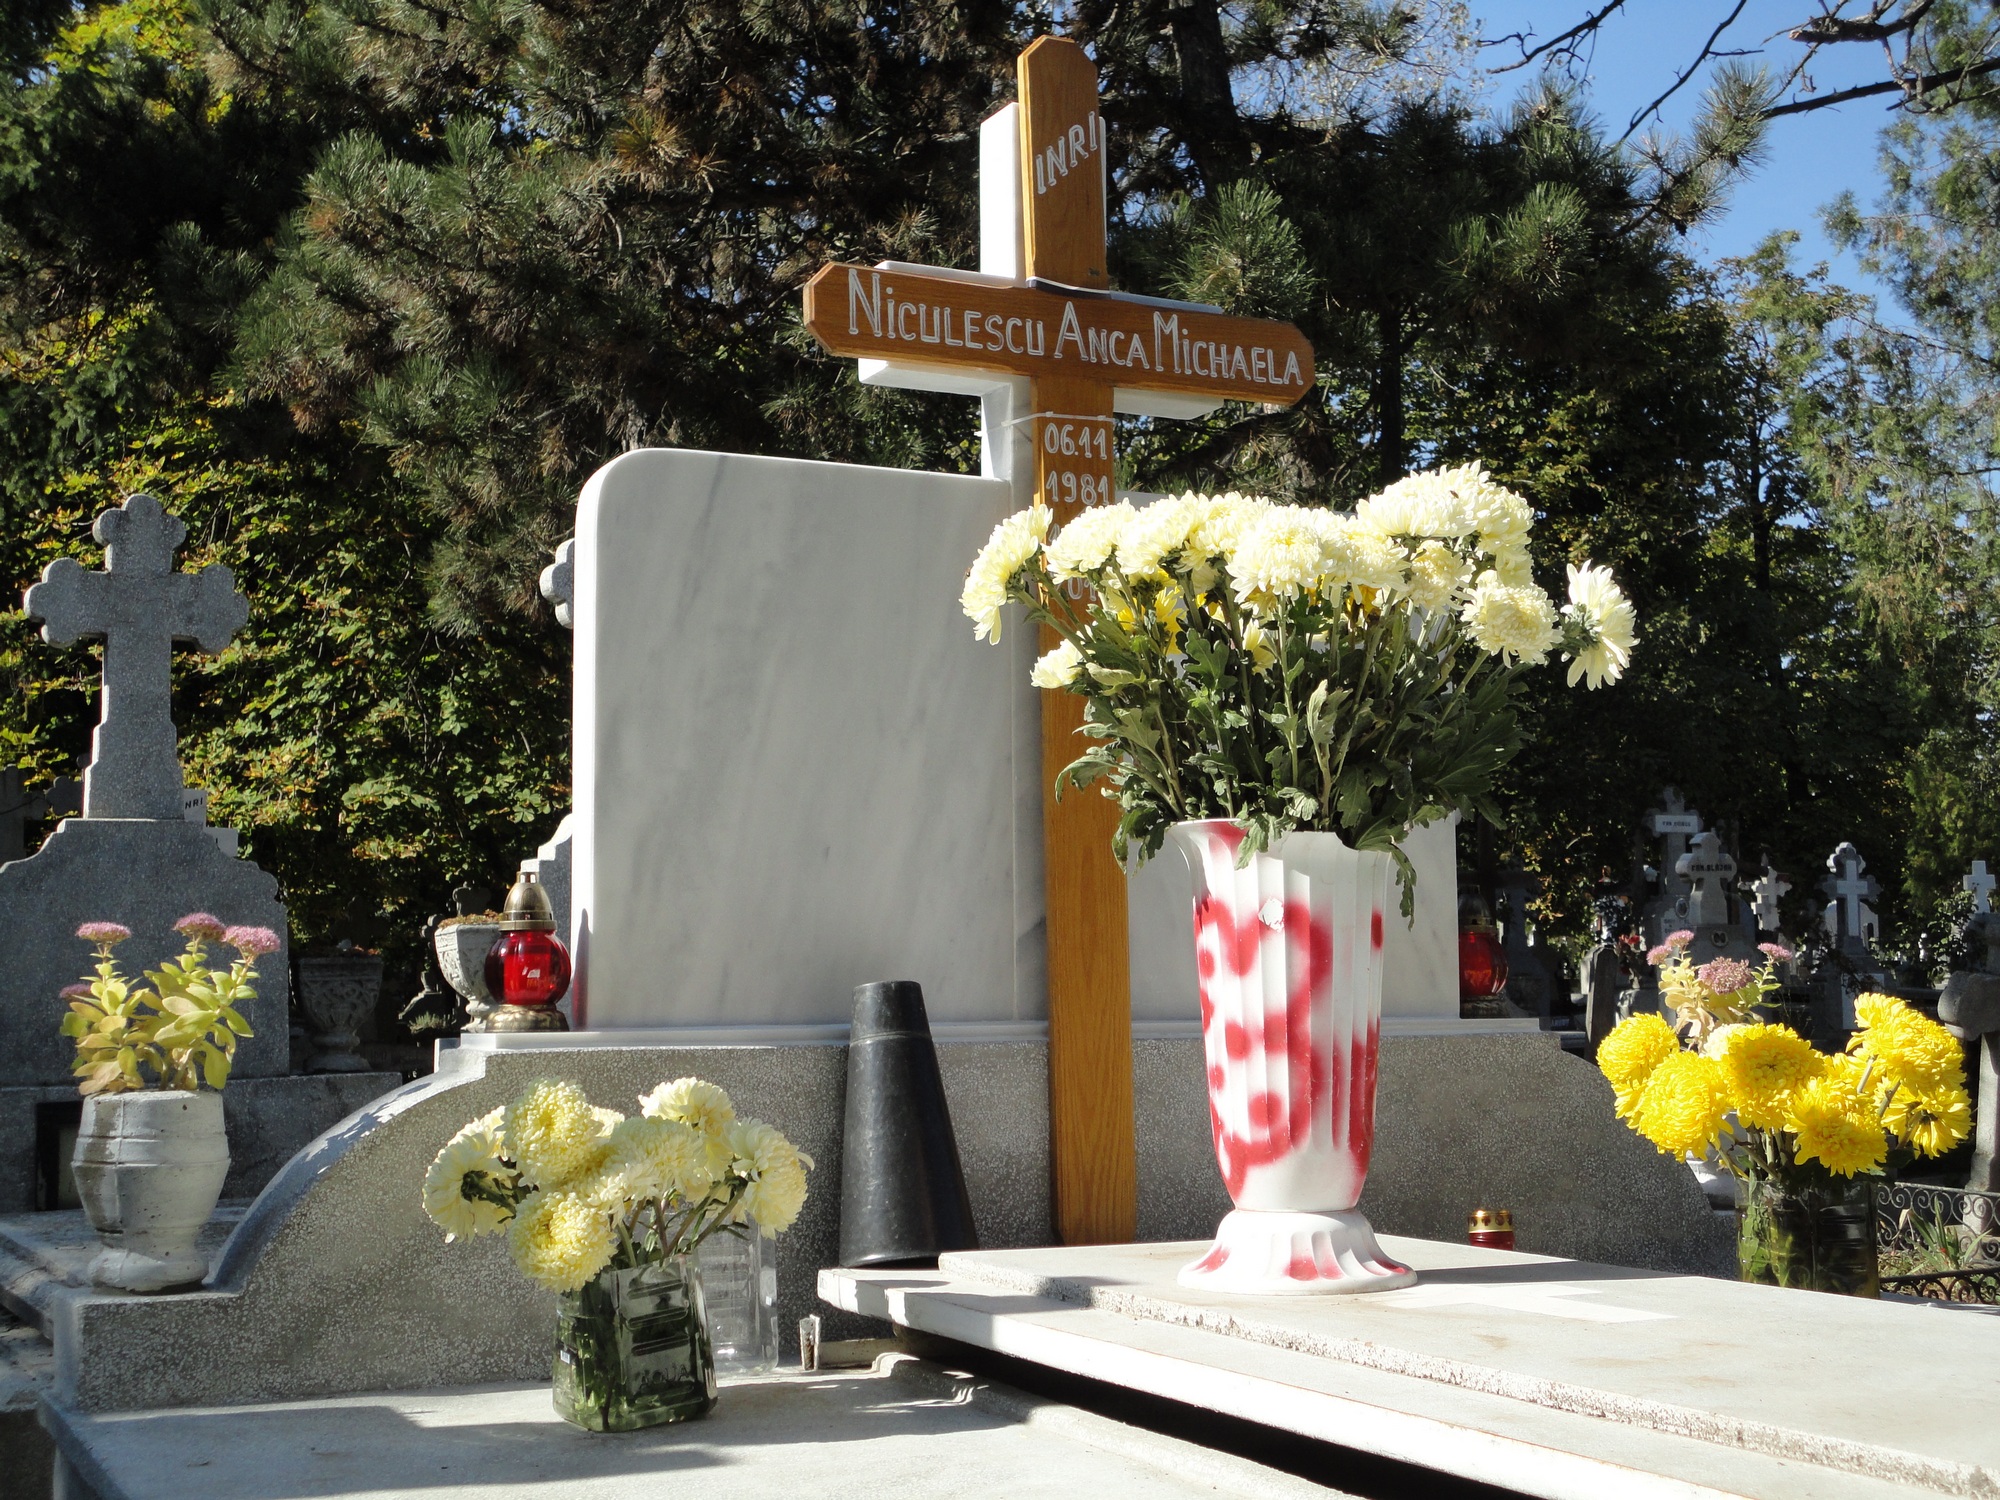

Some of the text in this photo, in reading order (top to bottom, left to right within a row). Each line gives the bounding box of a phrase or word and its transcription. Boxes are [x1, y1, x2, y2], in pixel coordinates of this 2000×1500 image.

[1036, 111, 1097, 194] INRI
[1054, 301, 1149, 369] ANCA
[1045, 423, 1107, 460] 06.11
[1046, 471, 1109, 505] 1981
[185, 797, 203, 809] NRI
